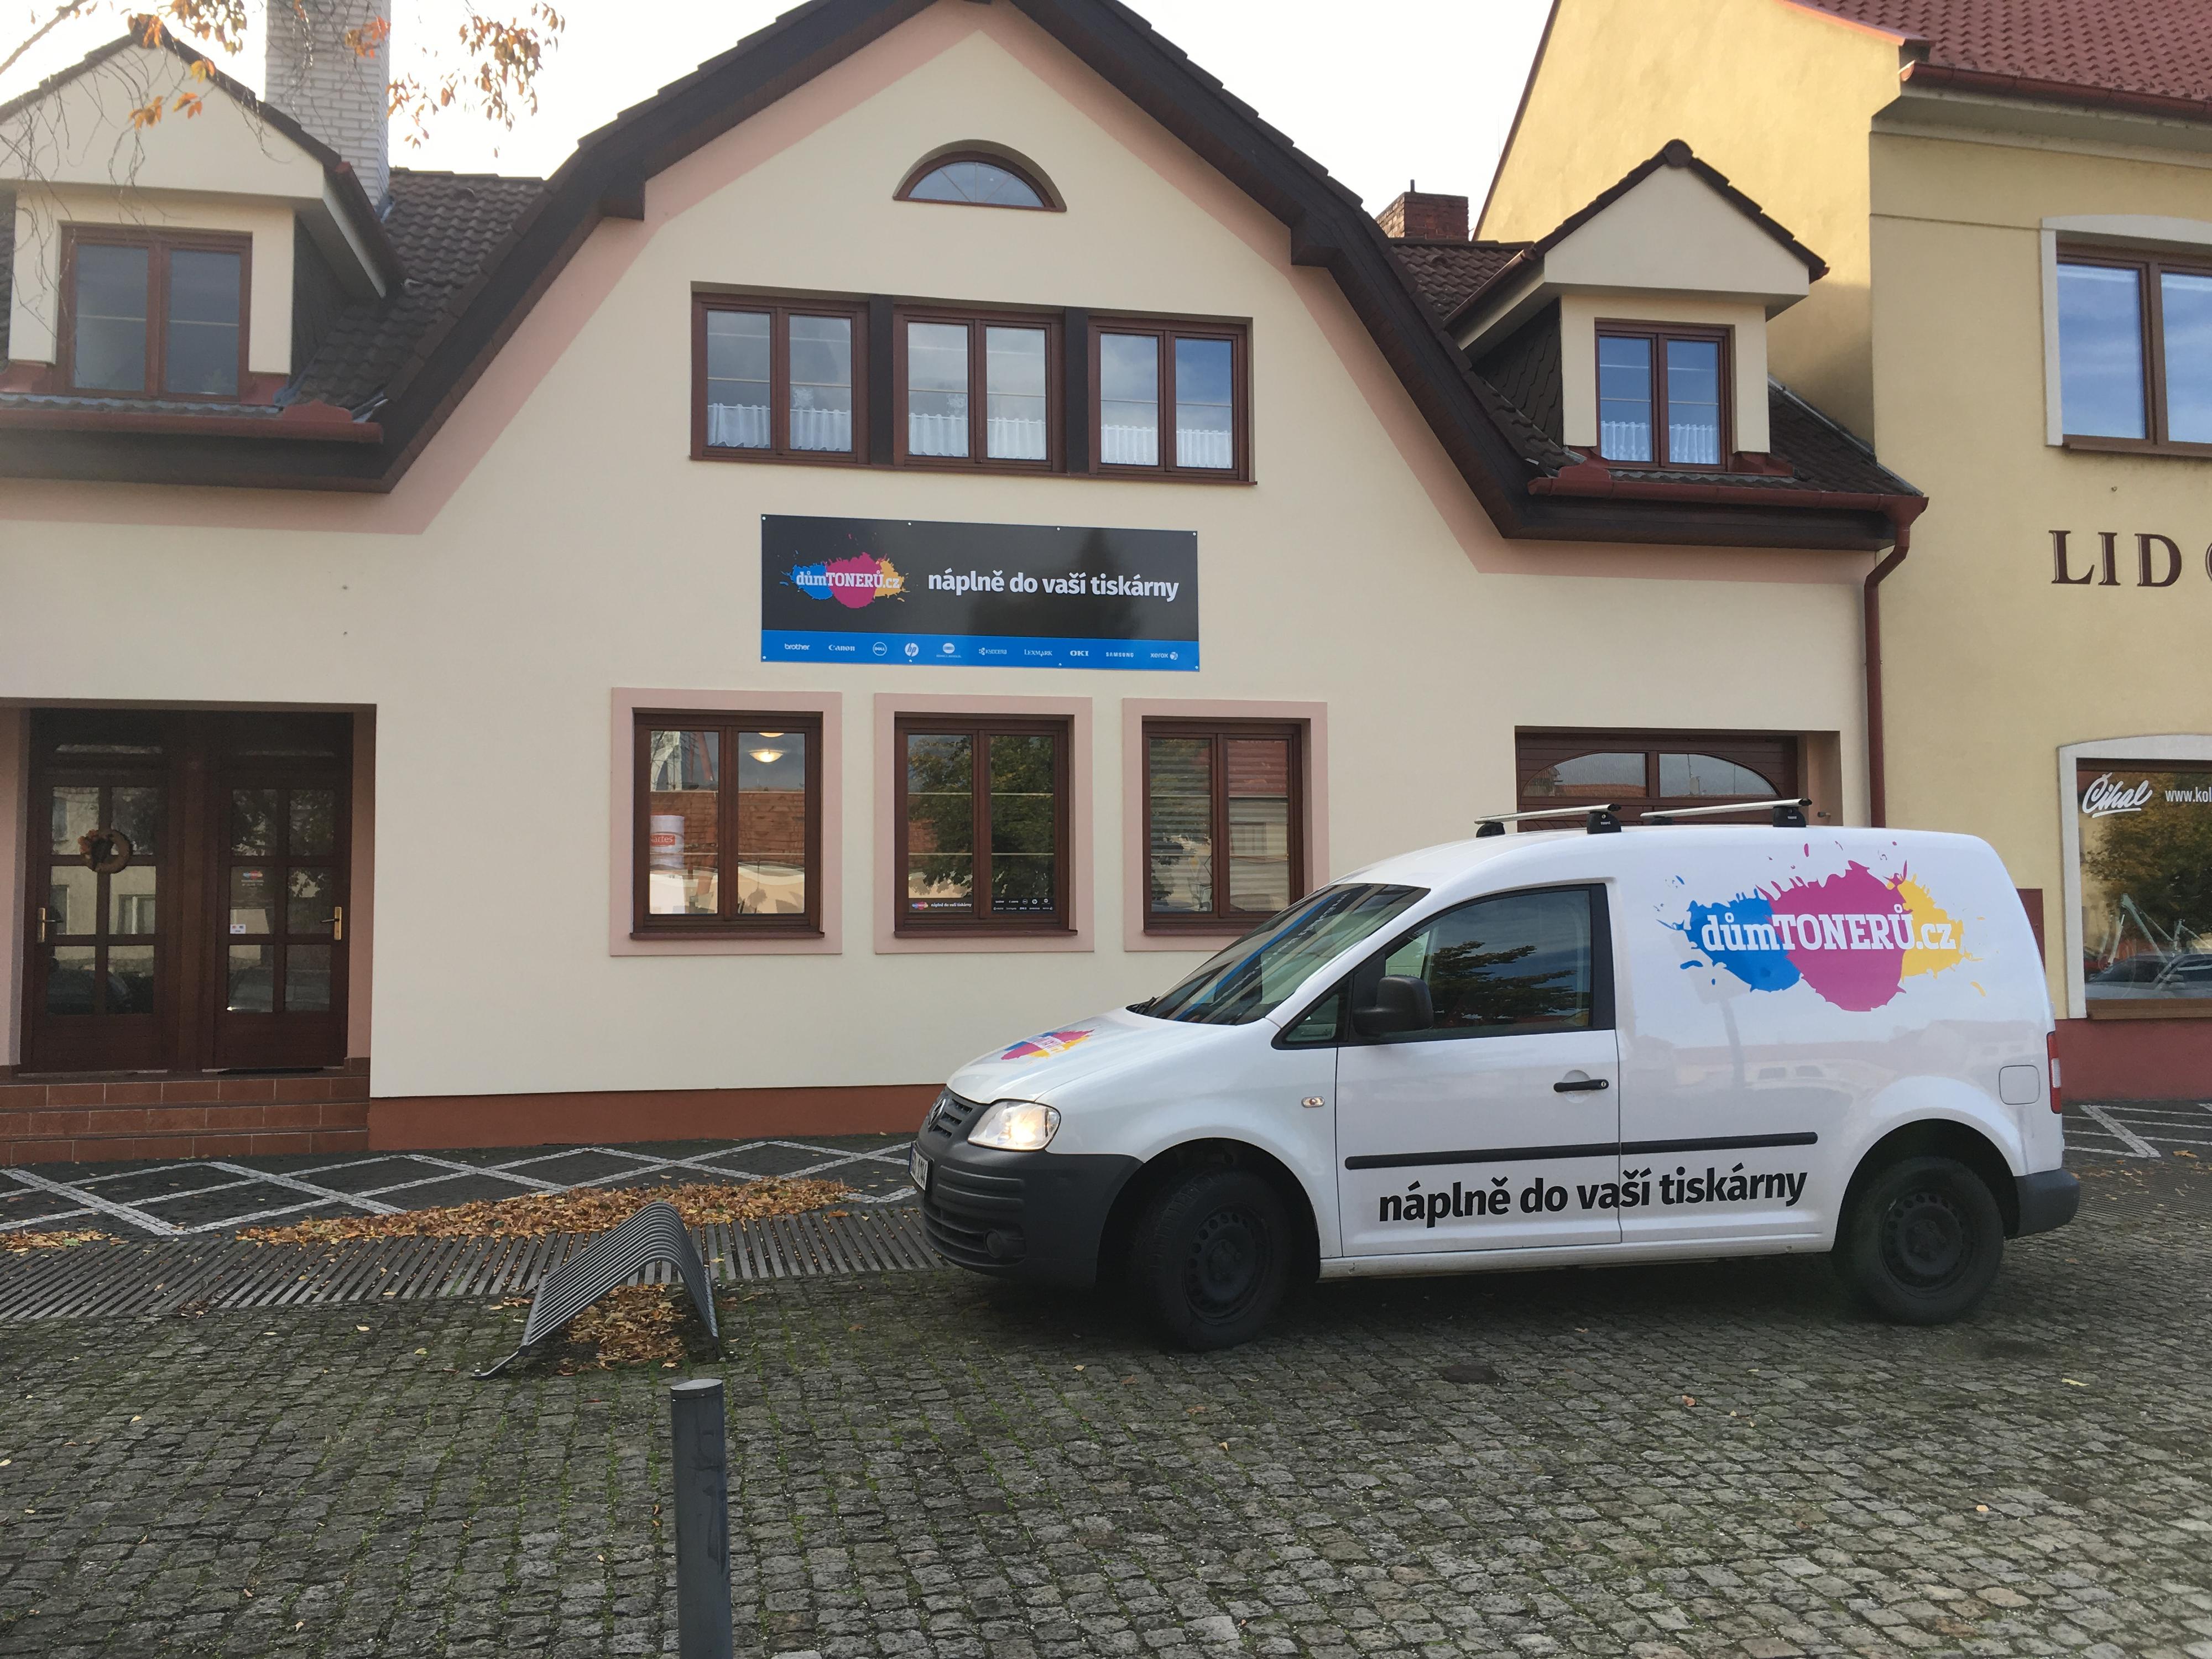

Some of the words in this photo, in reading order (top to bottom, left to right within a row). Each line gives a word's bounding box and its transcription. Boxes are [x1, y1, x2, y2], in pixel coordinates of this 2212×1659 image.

[796, 570, 900, 588] důmTONERŮ.cz
[2048, 530, 2212, 587] LID
[928, 567, 1004, 596] náplně
[1009, 572, 1037, 593] do
[1042, 572, 1087, 594] vaší
[1090, 573, 1180, 602] tiskárny
[906, 643, 917, 657] hp
[1702, 904, 1957, 952] důmTONERŮ.cz
[1379, 1176, 1510, 1228] náplně
[1520, 1177, 1568, 1215] do
[1578, 1167, 1652, 1210] vaší
[1659, 1161, 1808, 1207] tiskárny
